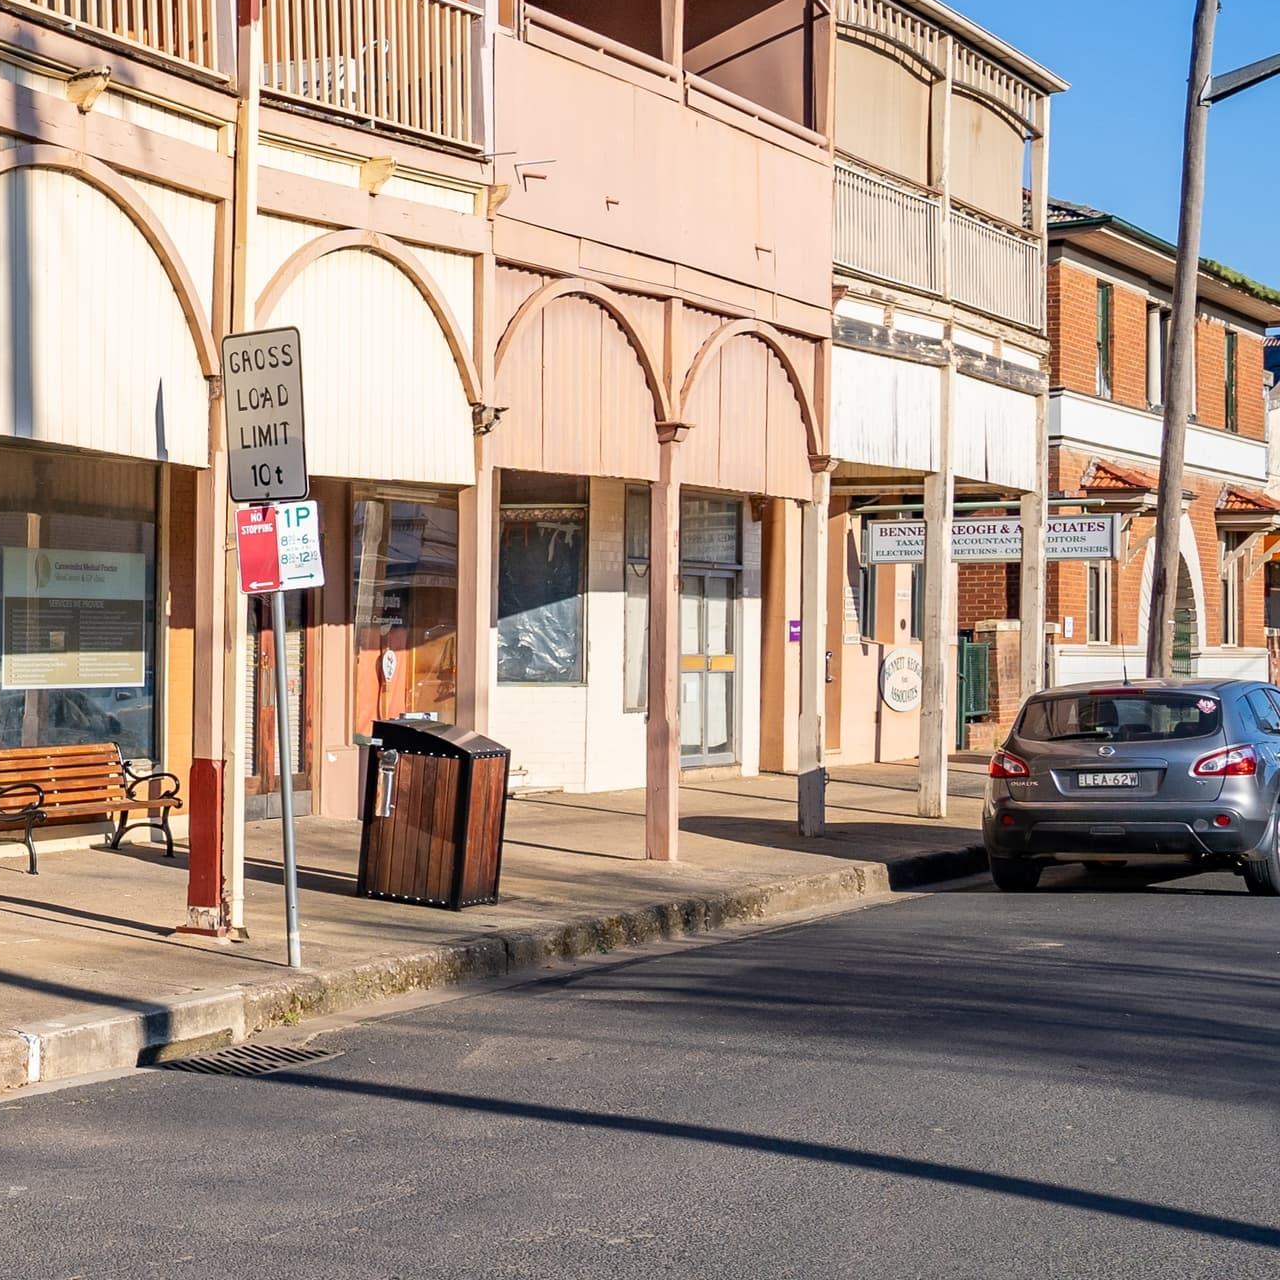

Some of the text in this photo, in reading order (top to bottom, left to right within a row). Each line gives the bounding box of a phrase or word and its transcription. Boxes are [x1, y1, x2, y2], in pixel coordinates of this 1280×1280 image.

[229, 343, 293, 374] GROSS
[237, 383, 288, 412] LOAD
[240, 421, 290, 449] LIMIT
[250, 511, 263, 523] NO
[284, 506, 311, 528] 1P
[241, 523, 274, 536] STOPPING
[880, 526, 926, 538] BENNE
[1000, 524, 1010, 534] &
[876, 548, 923, 557] ELECTRON
